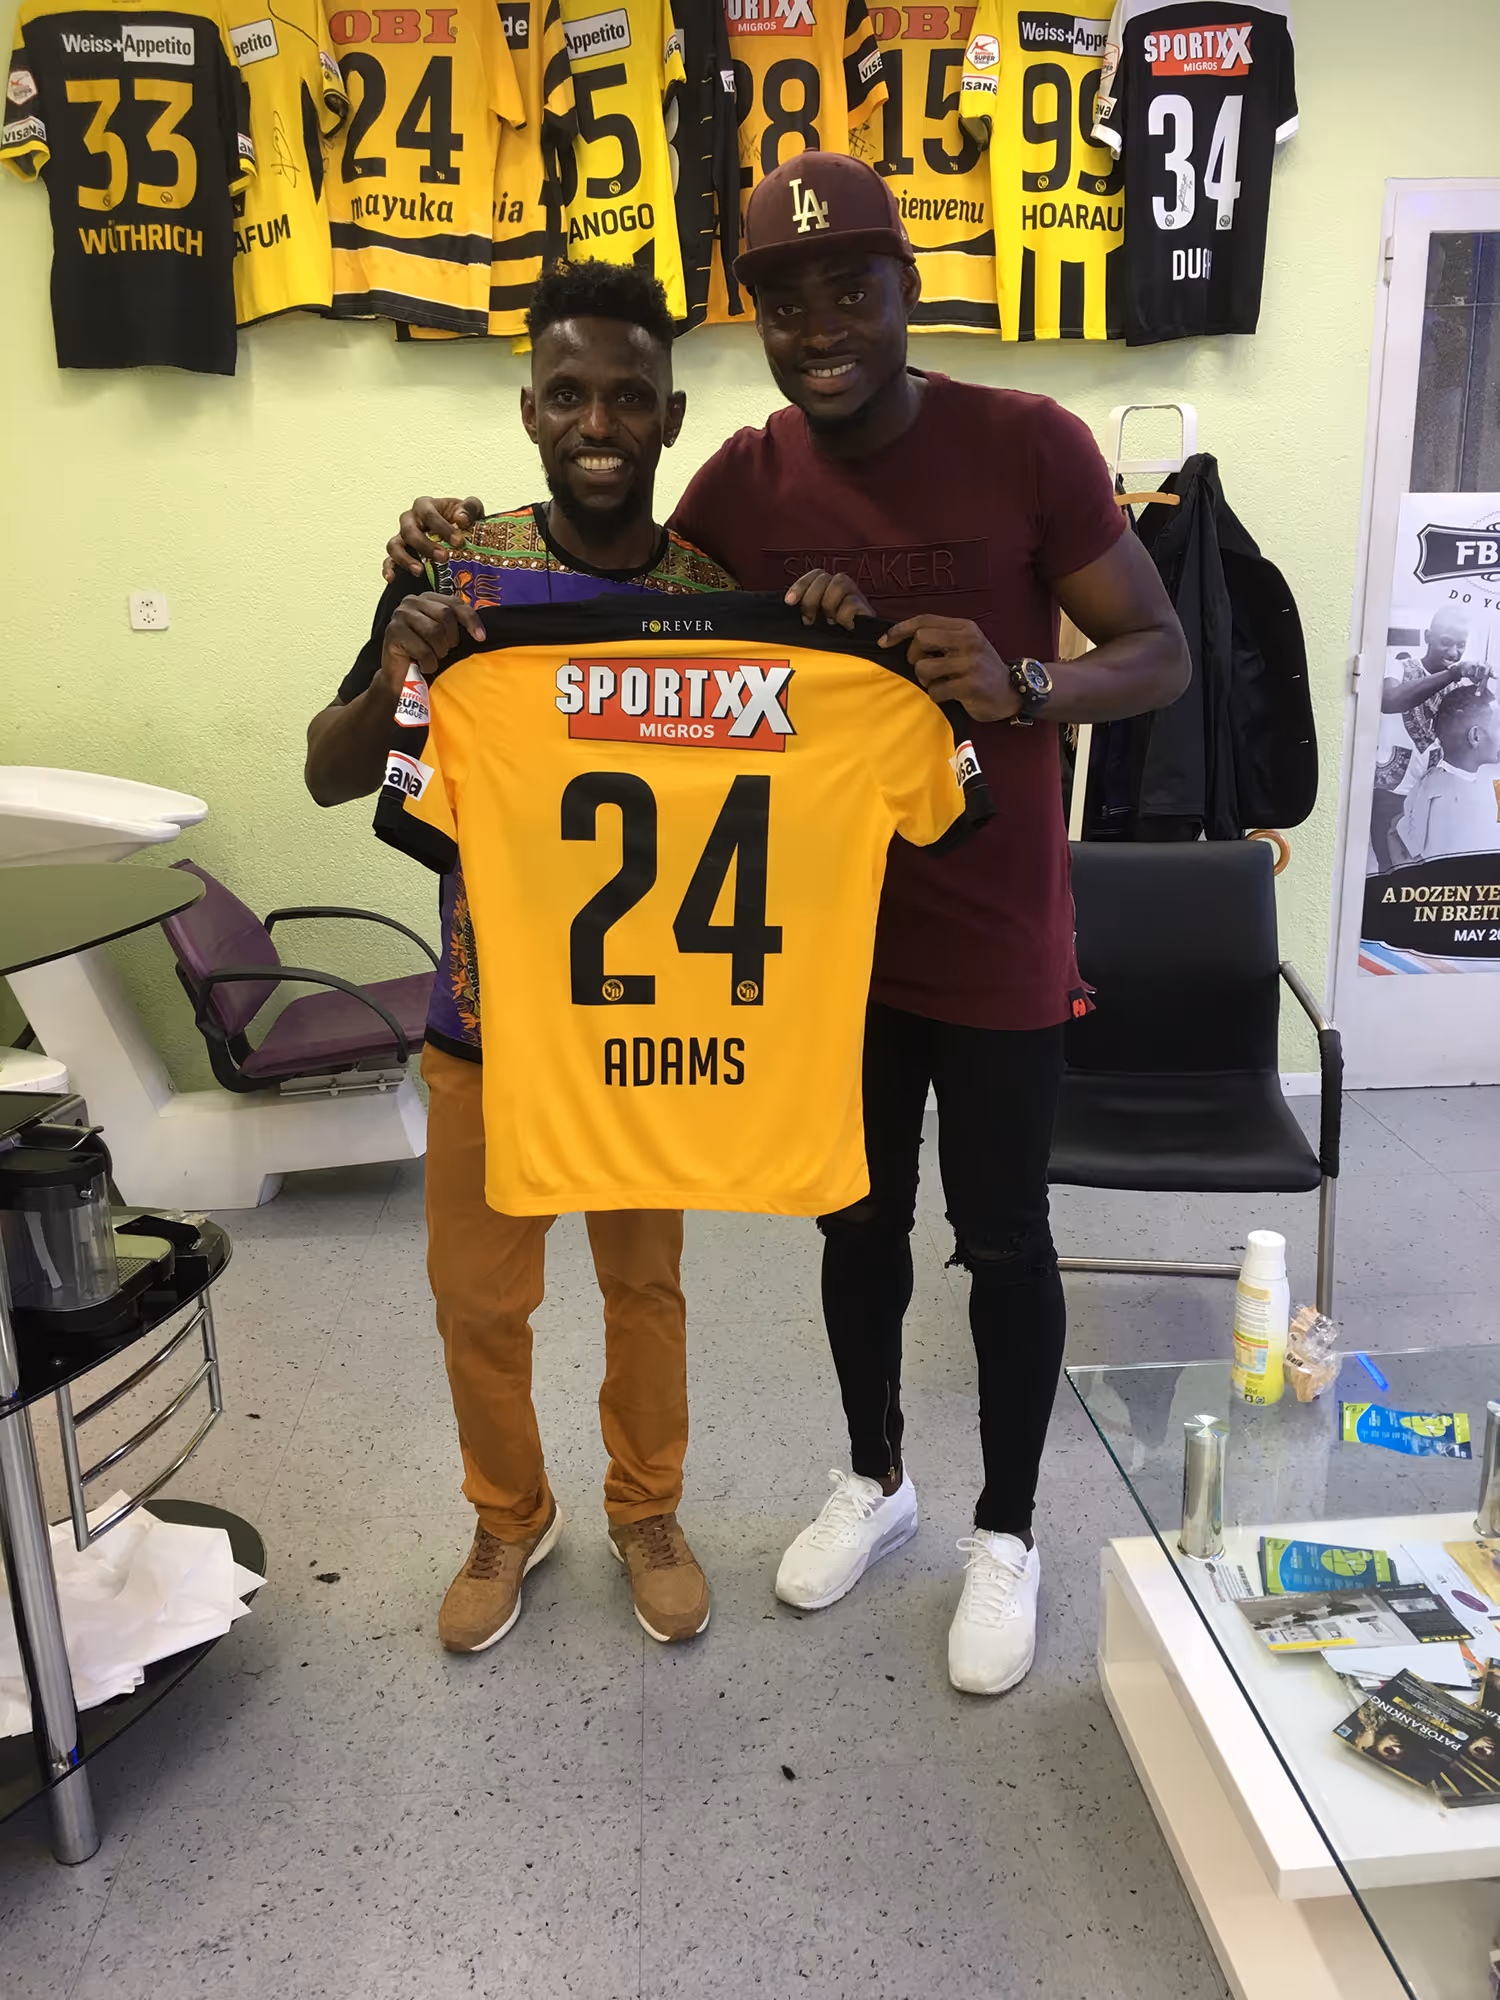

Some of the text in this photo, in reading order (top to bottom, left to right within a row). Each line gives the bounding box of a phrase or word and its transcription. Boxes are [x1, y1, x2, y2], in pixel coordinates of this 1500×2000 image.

[738, 22, 777, 32] MIGROS
[61, 33, 191, 57] Weiss+Appetito
[1183, 62, 1218, 72] MIGROS
[338, 52, 463, 185] 24
[65, 78, 197, 211] 33
[1148, 94, 1242, 230] 34
[789, 178, 829, 233] LA
[1023, 202, 1124, 232] HOARAU
[1448, 589, 1472, 603] DO
[641, 620, 714, 633] FOREVER
[639, 722, 716, 739] MIGROS
[560, 771, 783, 1006] 24
[1381, 887, 1397, 903] A
[1399, 886, 1472, 903] DOZEN
[1413, 906, 1438, 922] IN
[1454, 929, 1486, 942] MAY
[603, 1037, 746, 1087] ADAMS
